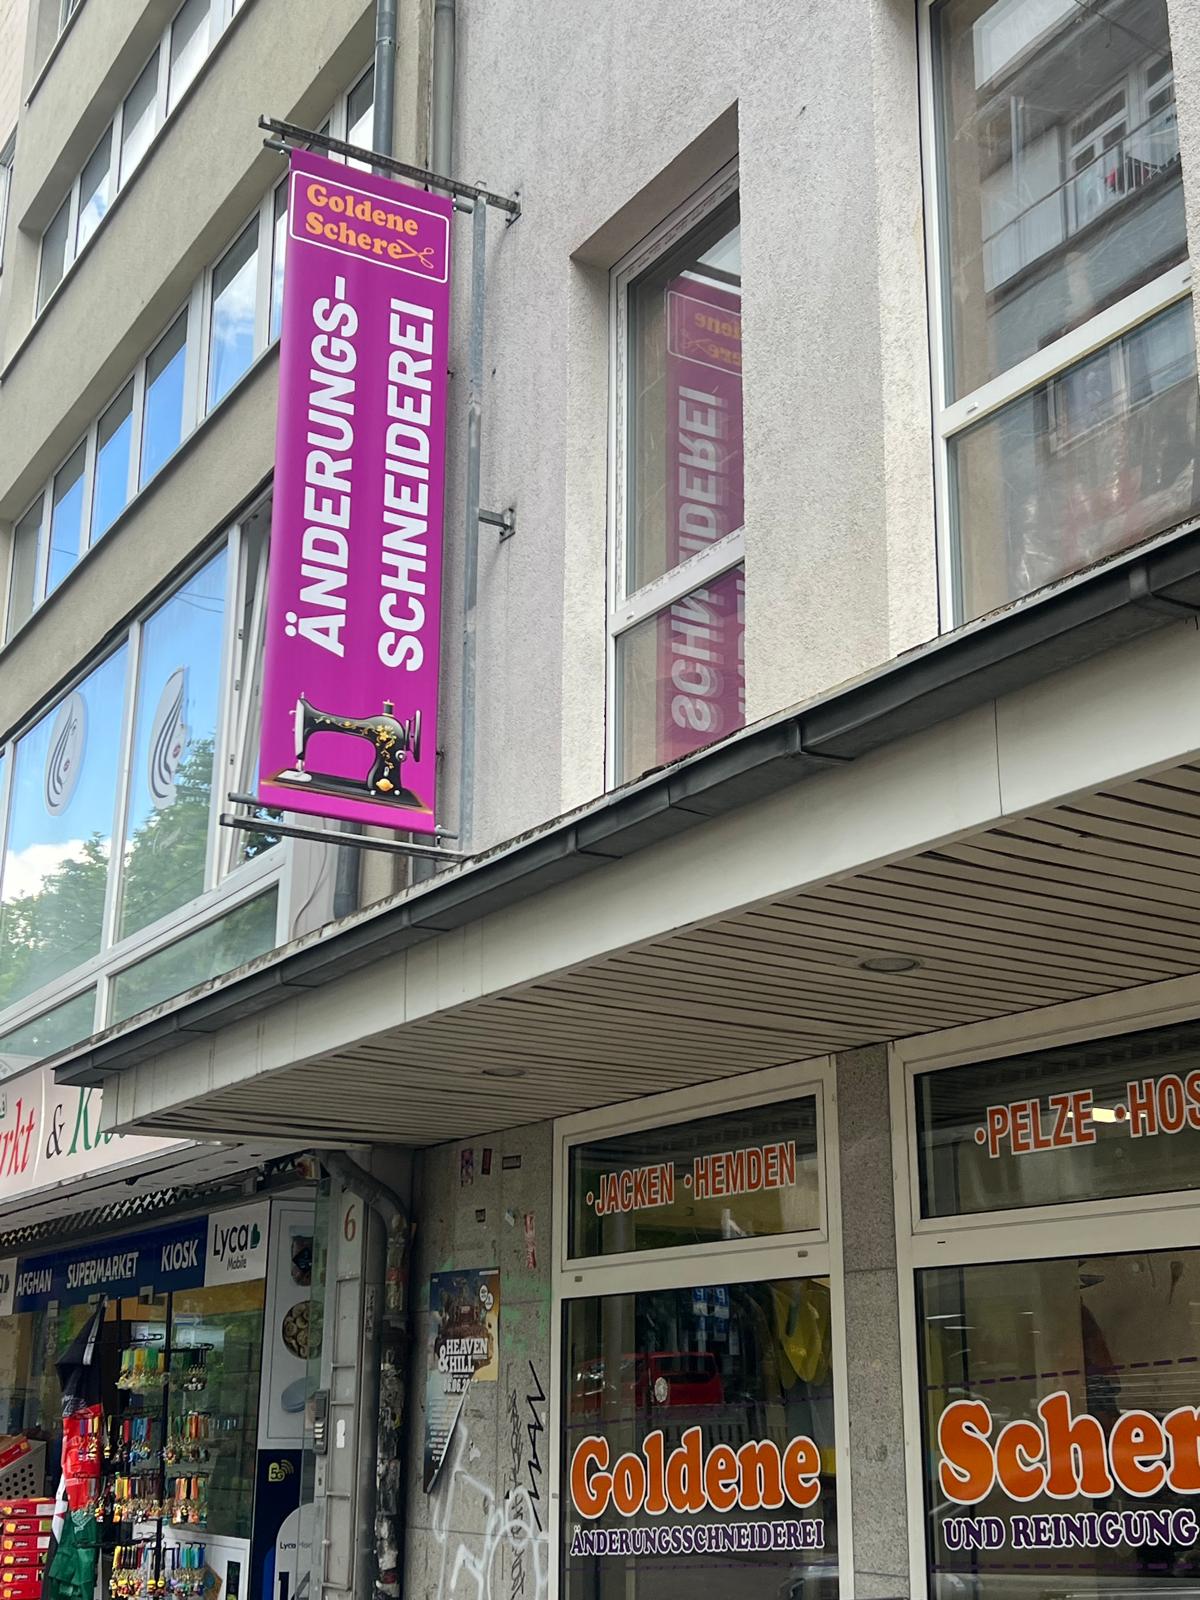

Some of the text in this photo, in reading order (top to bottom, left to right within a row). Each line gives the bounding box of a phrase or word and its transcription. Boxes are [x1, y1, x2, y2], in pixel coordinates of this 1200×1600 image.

[307, 184, 419, 236] Goldene
[305, 211, 403, 260] Schere
[285, 276, 359, 657] ÄNDERUNGS-
[378, 298, 434, 671] SCHNEIDEREI
[0, 1098, 35, 1177] rkt
[46, 1104, 65, 1159] &
[213, 1223, 250, 1262] Lyca
[343, 1204, 357, 1242] 6
[16, 1268, 52, 1297] AFGHAN
[66, 1252, 139, 1289] SUPERMARKET
[161, 1240, 198, 1272] KIOSK
[227, 1255, 248, 1271] Mobile
[446, 1338, 488, 1355] HEAVEN
[449, 1355, 475, 1373] HILL
[571, 1426, 821, 1519] Goldene
[570, 1519, 825, 1555] ÄNDERUNGSSCHNEIDEREI
[943, 1509, 1199, 1550] UND REINIGUNG
